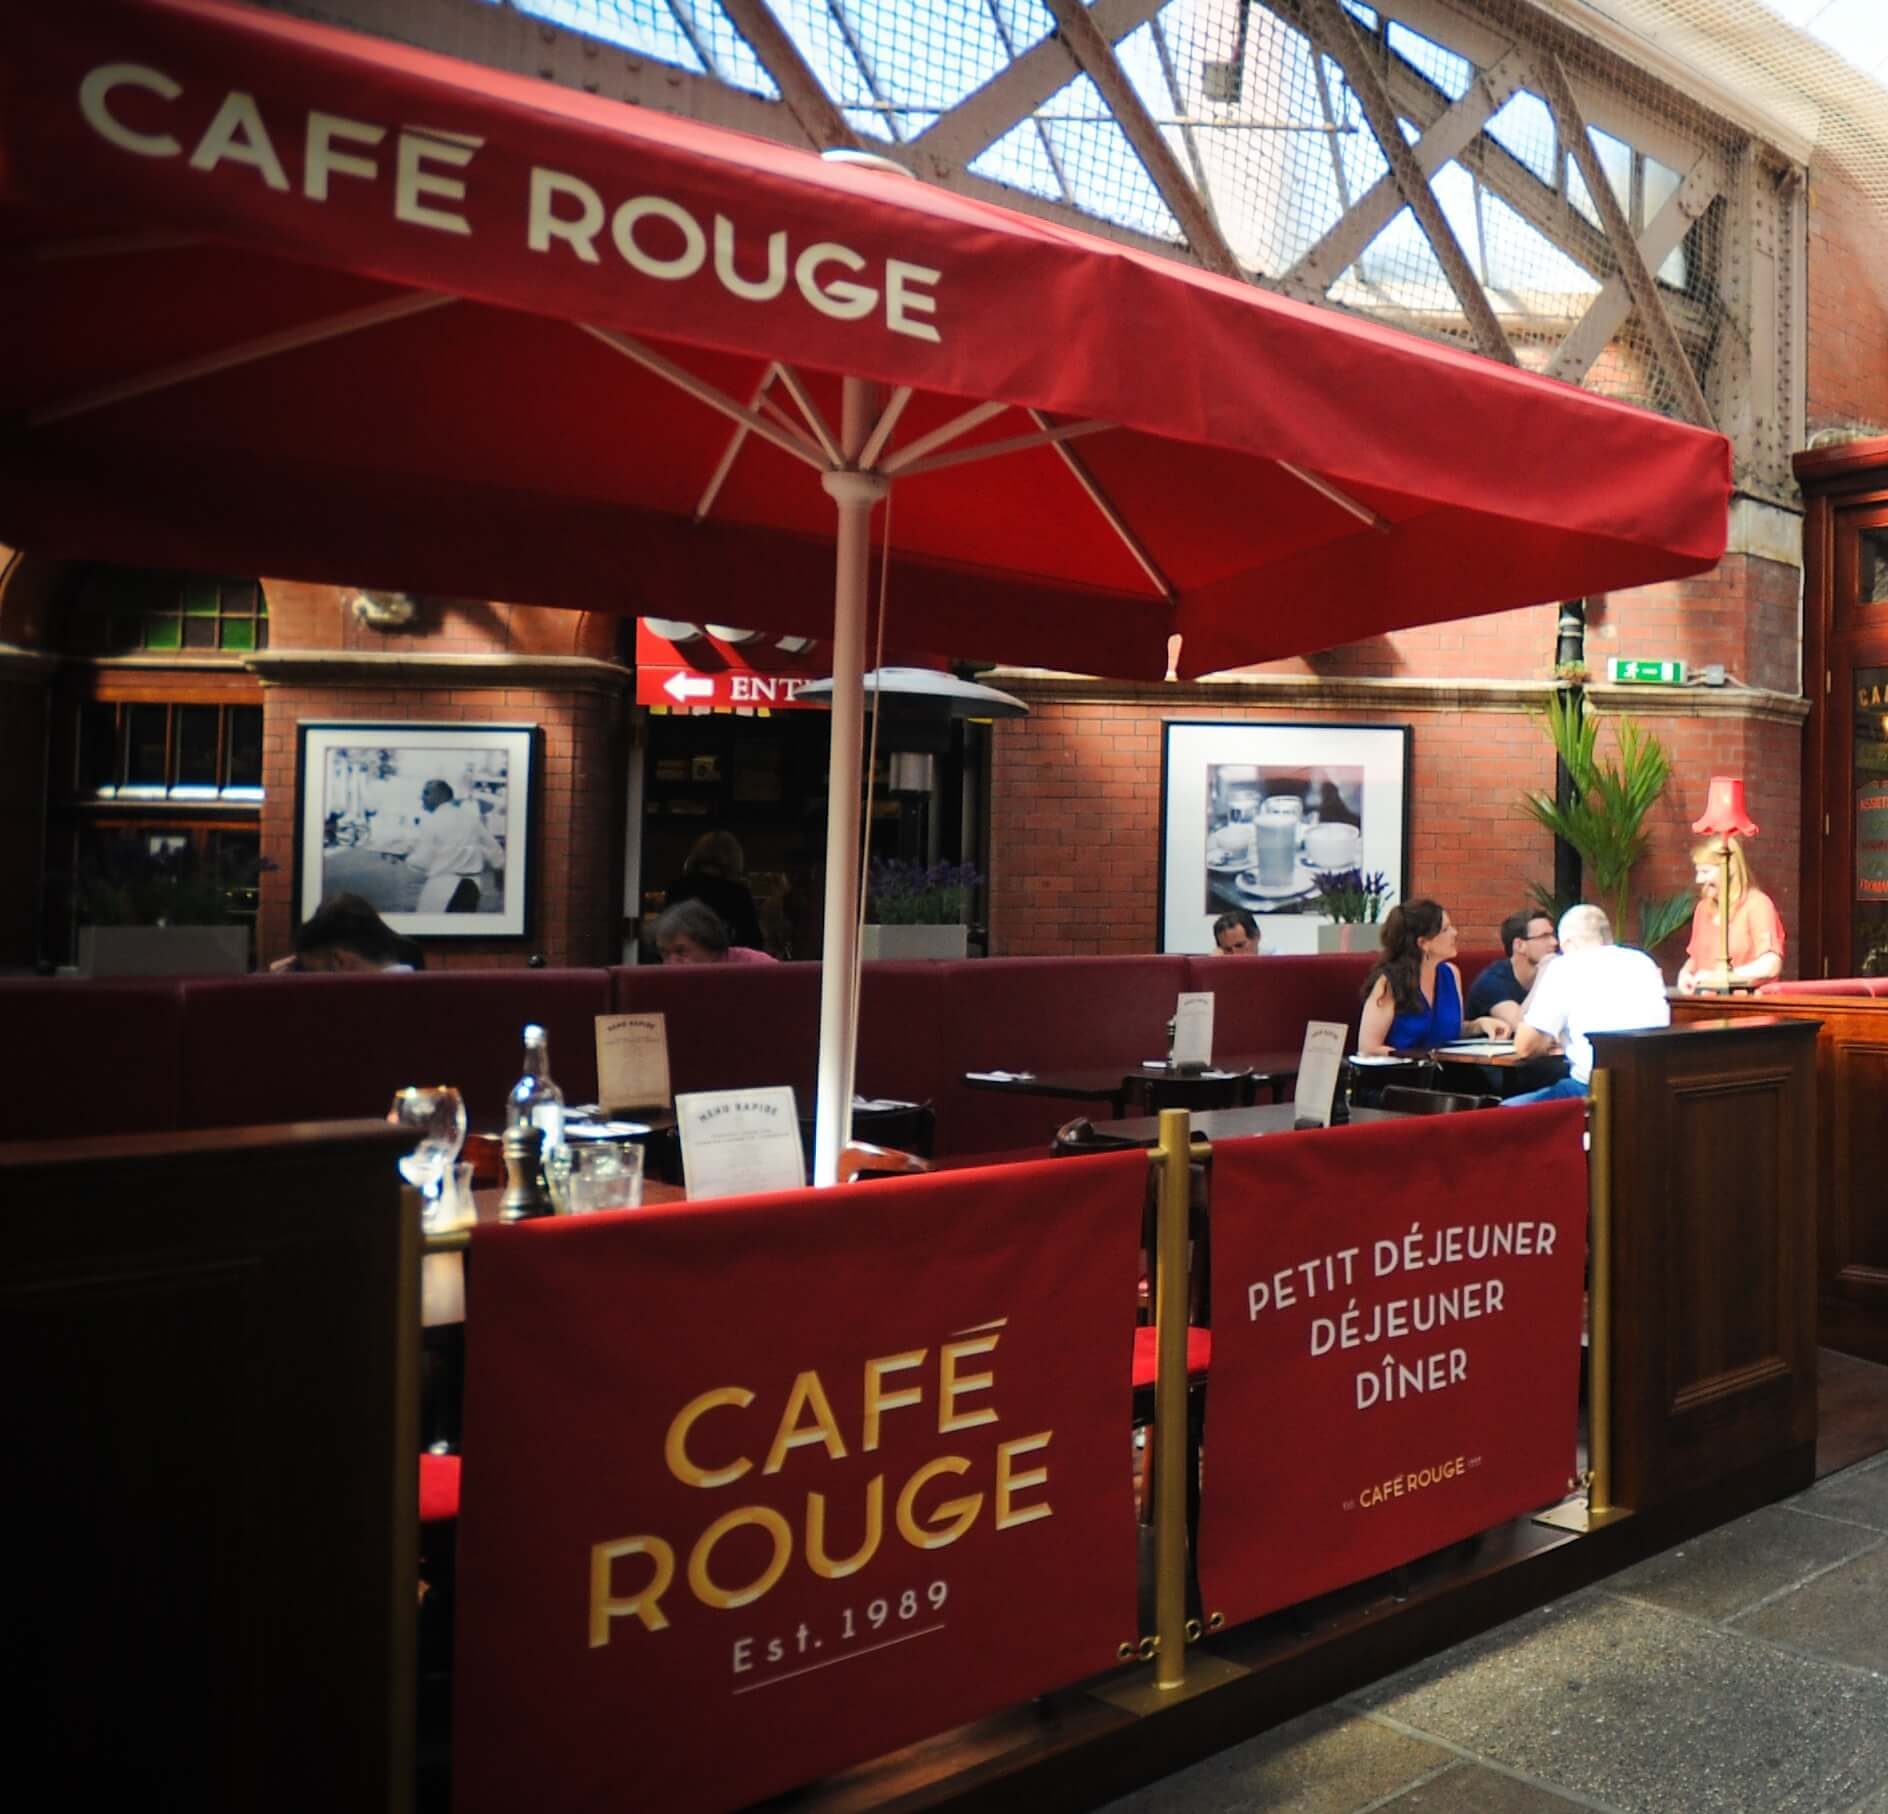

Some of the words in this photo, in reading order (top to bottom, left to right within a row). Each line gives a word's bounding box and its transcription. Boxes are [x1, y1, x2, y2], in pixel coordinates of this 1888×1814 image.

[79, 63, 486, 237] CAFÉ
[527, 167, 944, 343] ROUGE
[730, 676, 806, 701] ENT
[735, 1102, 778, 1117] RAPIDE
[1247, 1248, 1360, 1322] PETIT
[1373, 1221, 1558, 1278] DÉJEUNER
[1310, 1279, 1505, 1357] DÉJEUNER
[664, 1317, 1009, 1490] CAFÉ
[1355, 1347, 1468, 1411] DÎNER
[1407, 1456, 1466, 1493] ROUGE
[588, 1430, 1054, 1650] ROUGE
[732, 1622, 823, 1674] Est.
[840, 1580, 949, 1642] 1989
